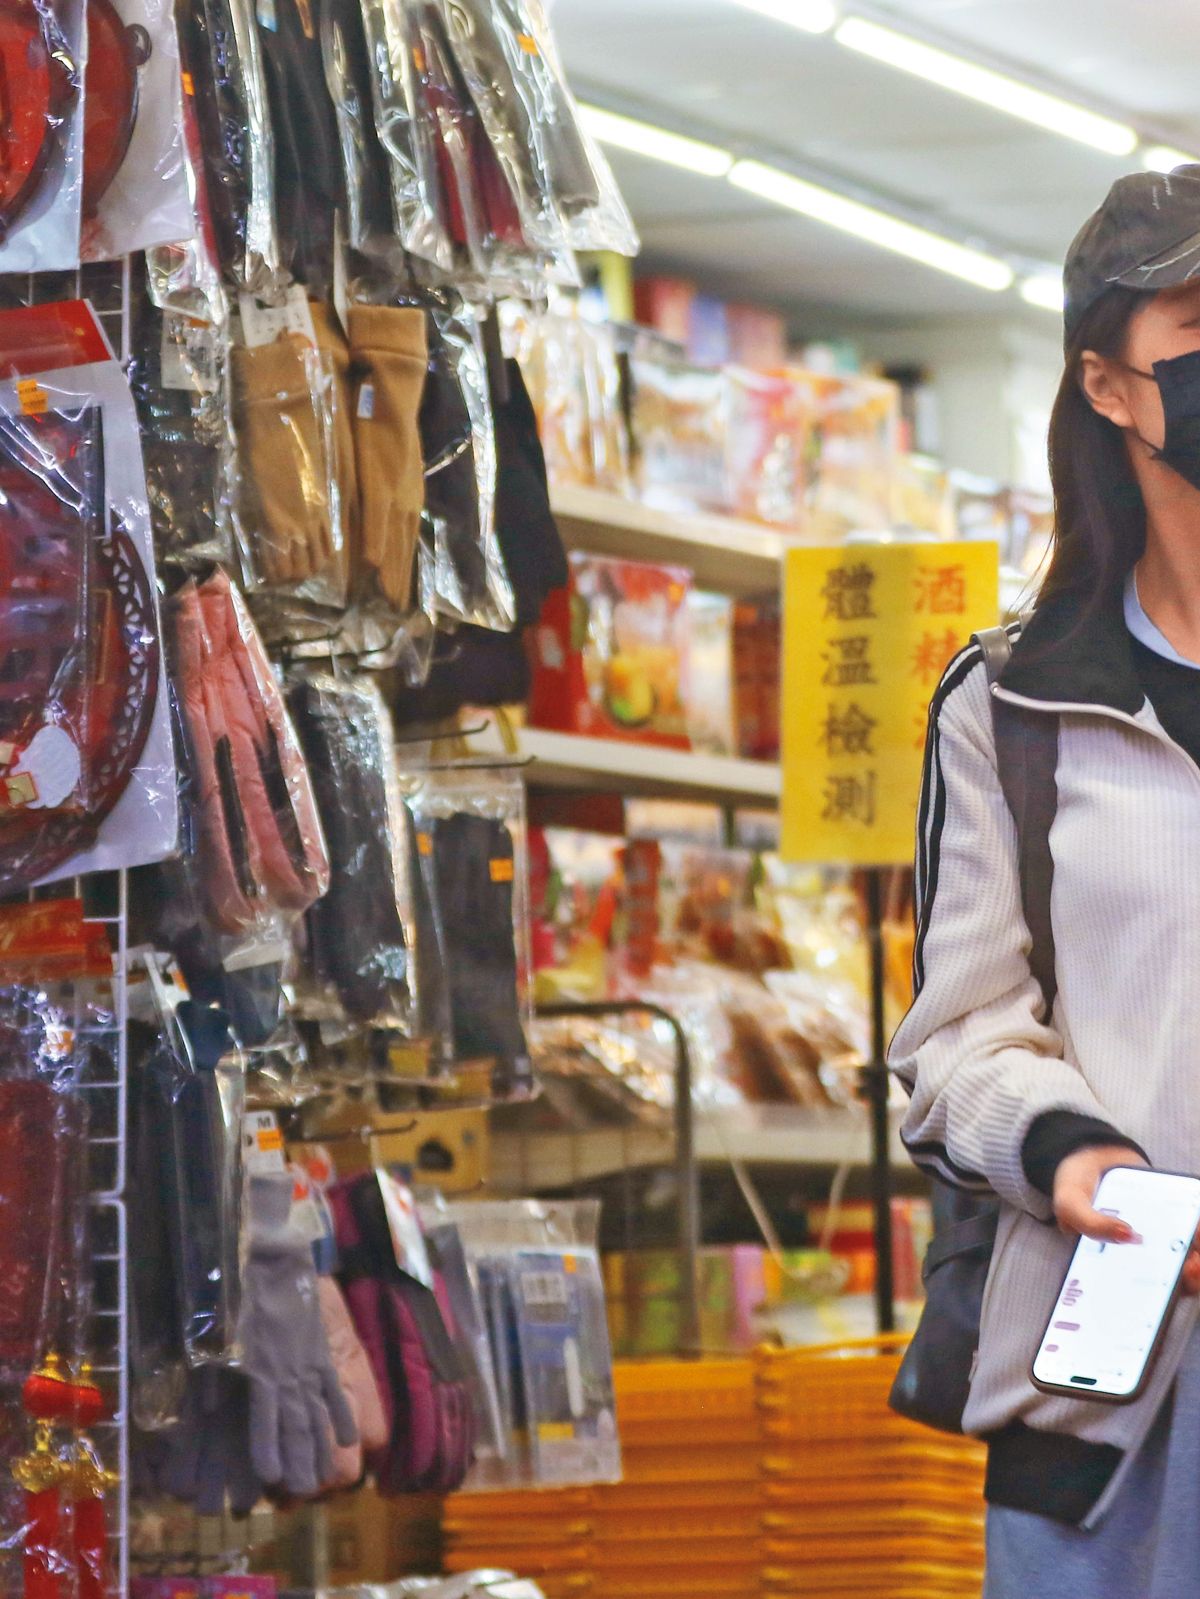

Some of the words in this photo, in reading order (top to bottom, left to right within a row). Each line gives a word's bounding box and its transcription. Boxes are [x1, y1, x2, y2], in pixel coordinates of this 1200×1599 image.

[820, 562, 878, 827] 體溫檢測
[912, 563, 967, 749] 酒精
